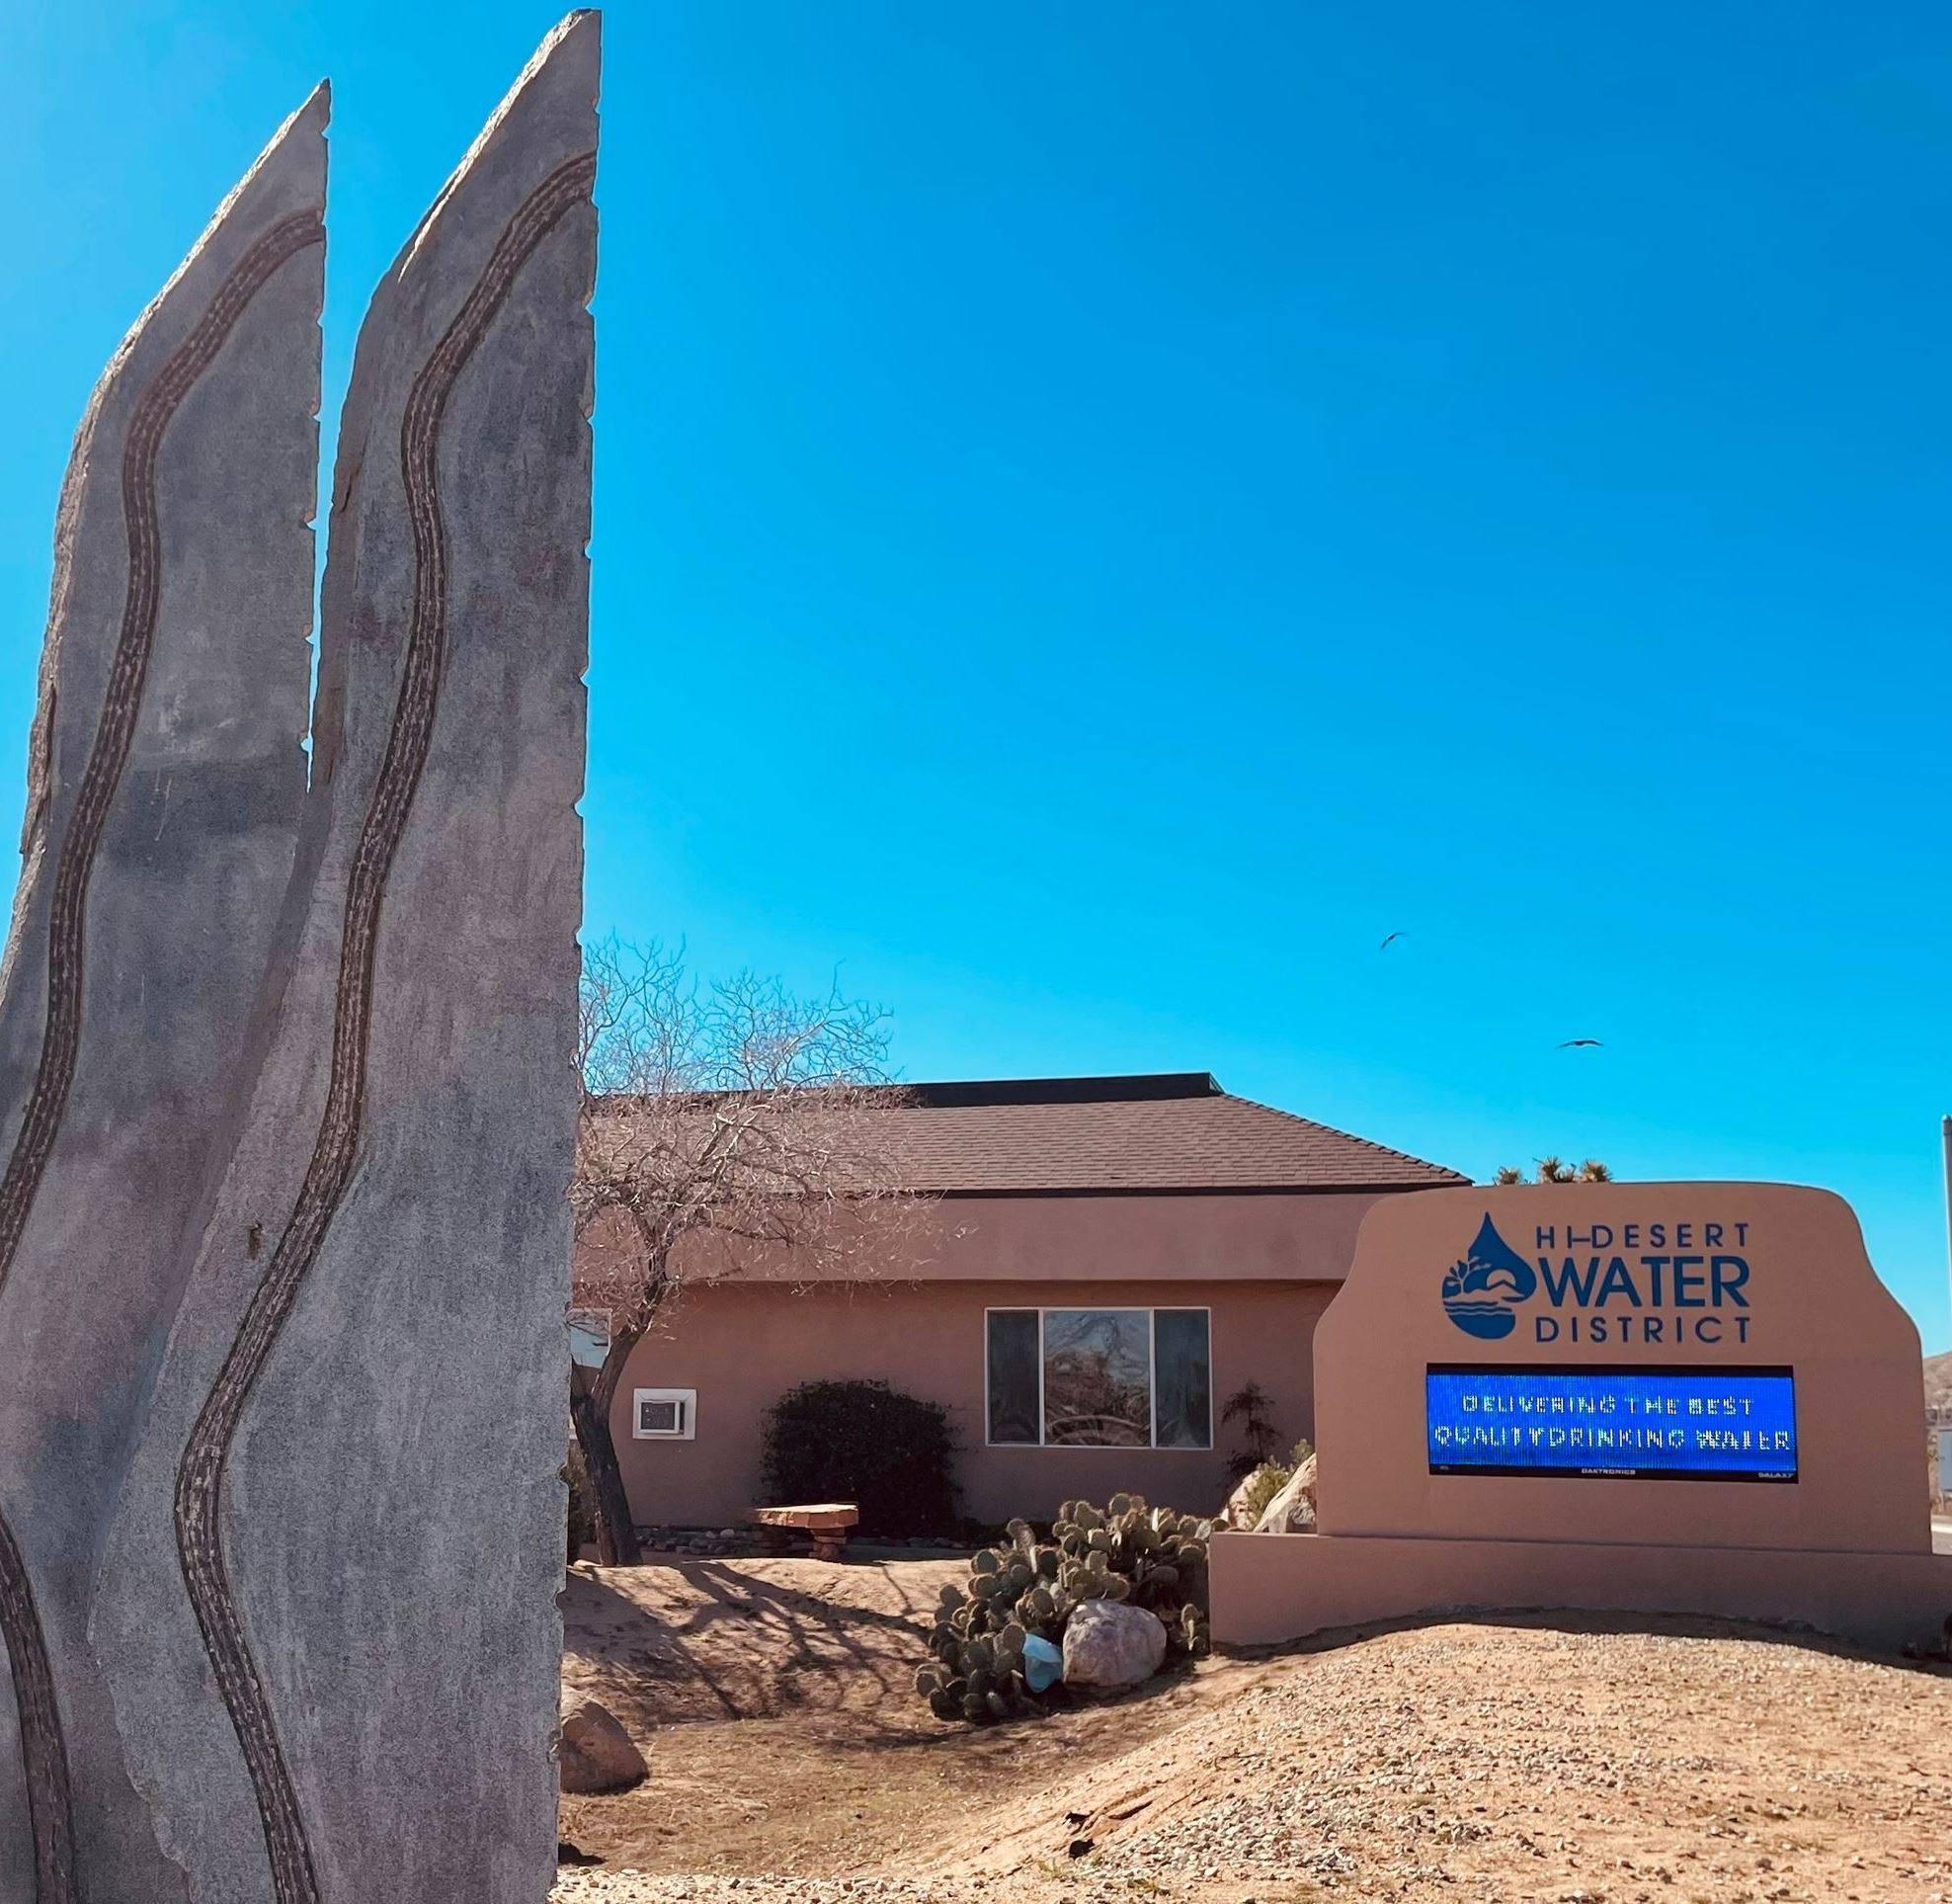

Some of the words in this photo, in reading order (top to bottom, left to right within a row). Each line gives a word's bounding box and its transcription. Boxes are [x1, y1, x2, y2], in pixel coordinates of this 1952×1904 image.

[1536, 1223, 1749, 1249] HI-DESERT
[1537, 1256, 1750, 1307] WATER
[1535, 1316, 1750, 1343] DISTRICT
[1462, 1394, 1616, 1414] DELIVERING
[1624, 1395, 1678, 1414] THE
[1688, 1396, 1754, 1415] BEST
[1695, 1429, 1791, 1450] WATER
